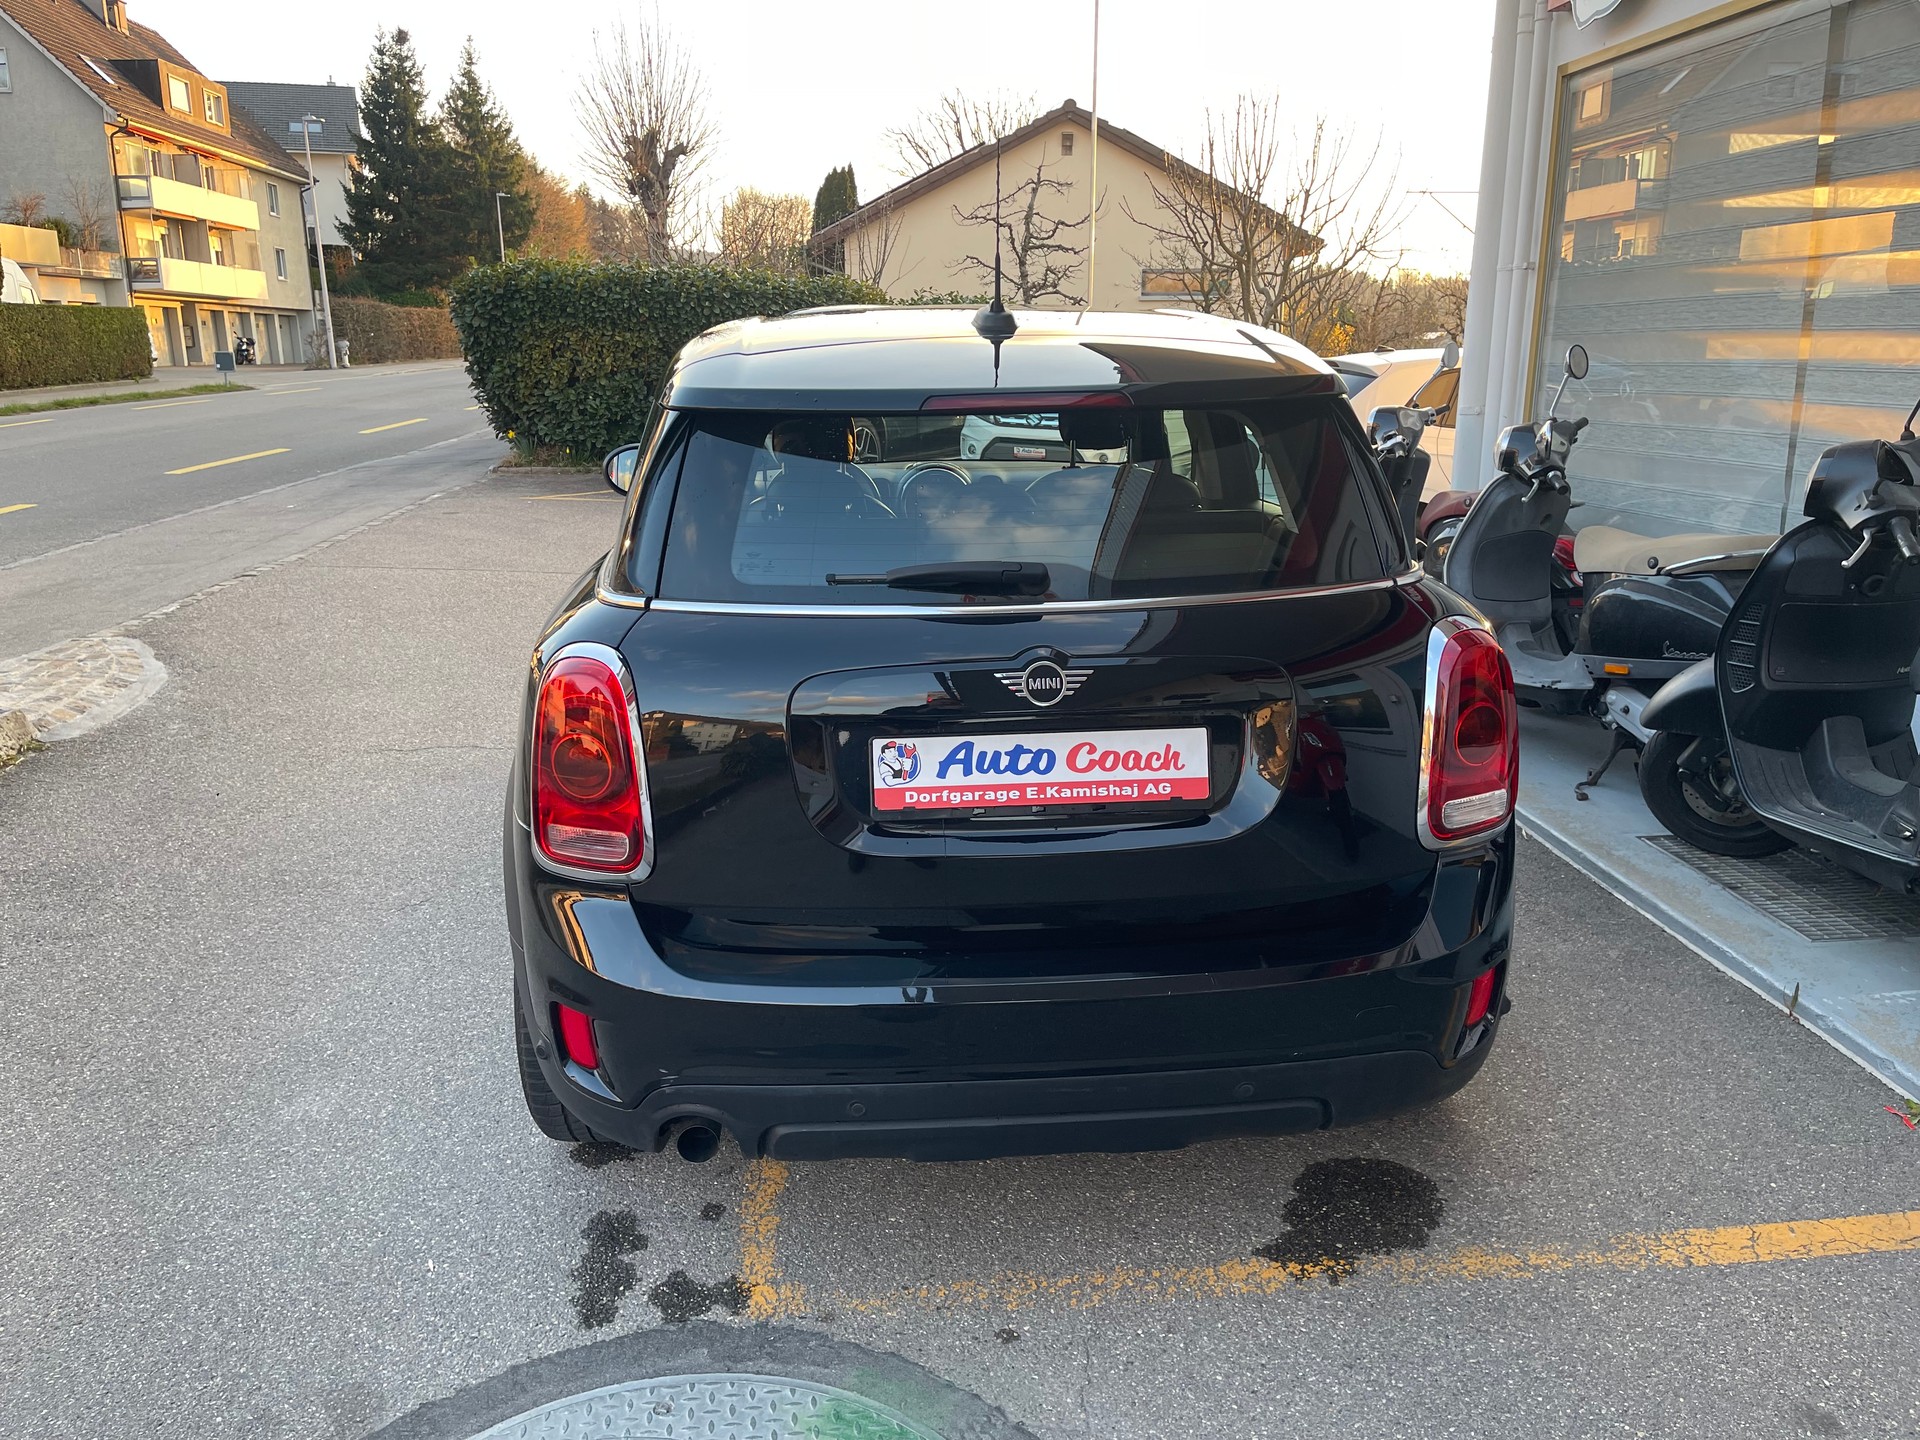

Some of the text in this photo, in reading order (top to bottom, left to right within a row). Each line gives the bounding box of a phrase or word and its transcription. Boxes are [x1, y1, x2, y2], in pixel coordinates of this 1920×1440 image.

[1028, 677, 1061, 690] MINI
[936, 740, 1186, 779] Auto Coach
[905, 782, 1172, 804] Dorfgarage E.Kamishaj AG
